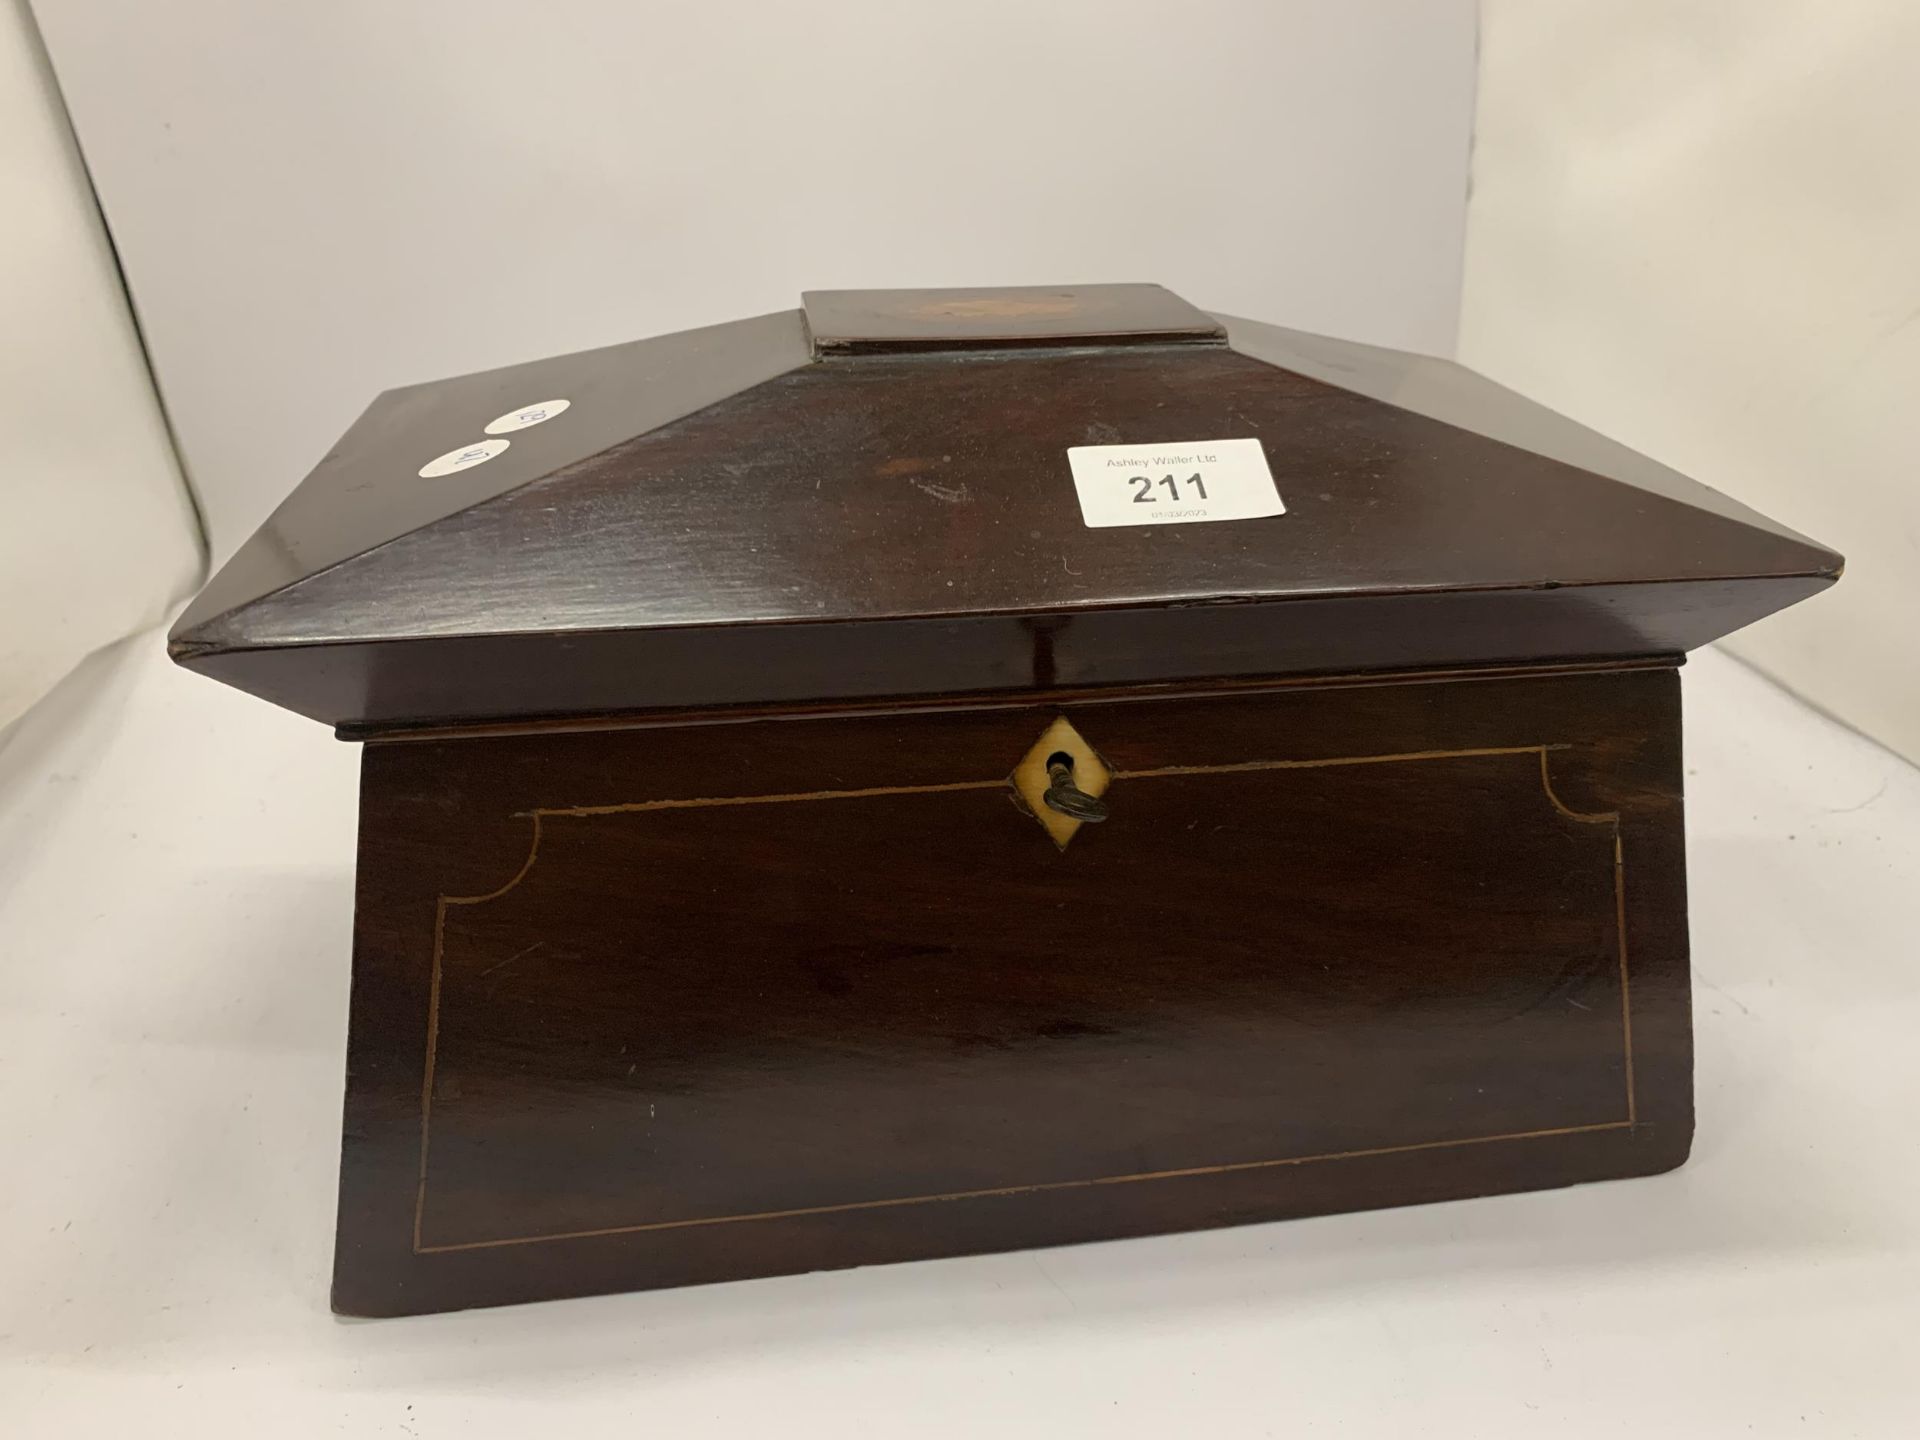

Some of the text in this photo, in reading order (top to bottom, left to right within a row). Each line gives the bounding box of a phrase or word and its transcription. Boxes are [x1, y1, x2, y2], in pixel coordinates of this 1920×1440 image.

[1106, 453, 1217, 469] Ashley Waller Ltd
[1128, 472, 1208, 503] 211
